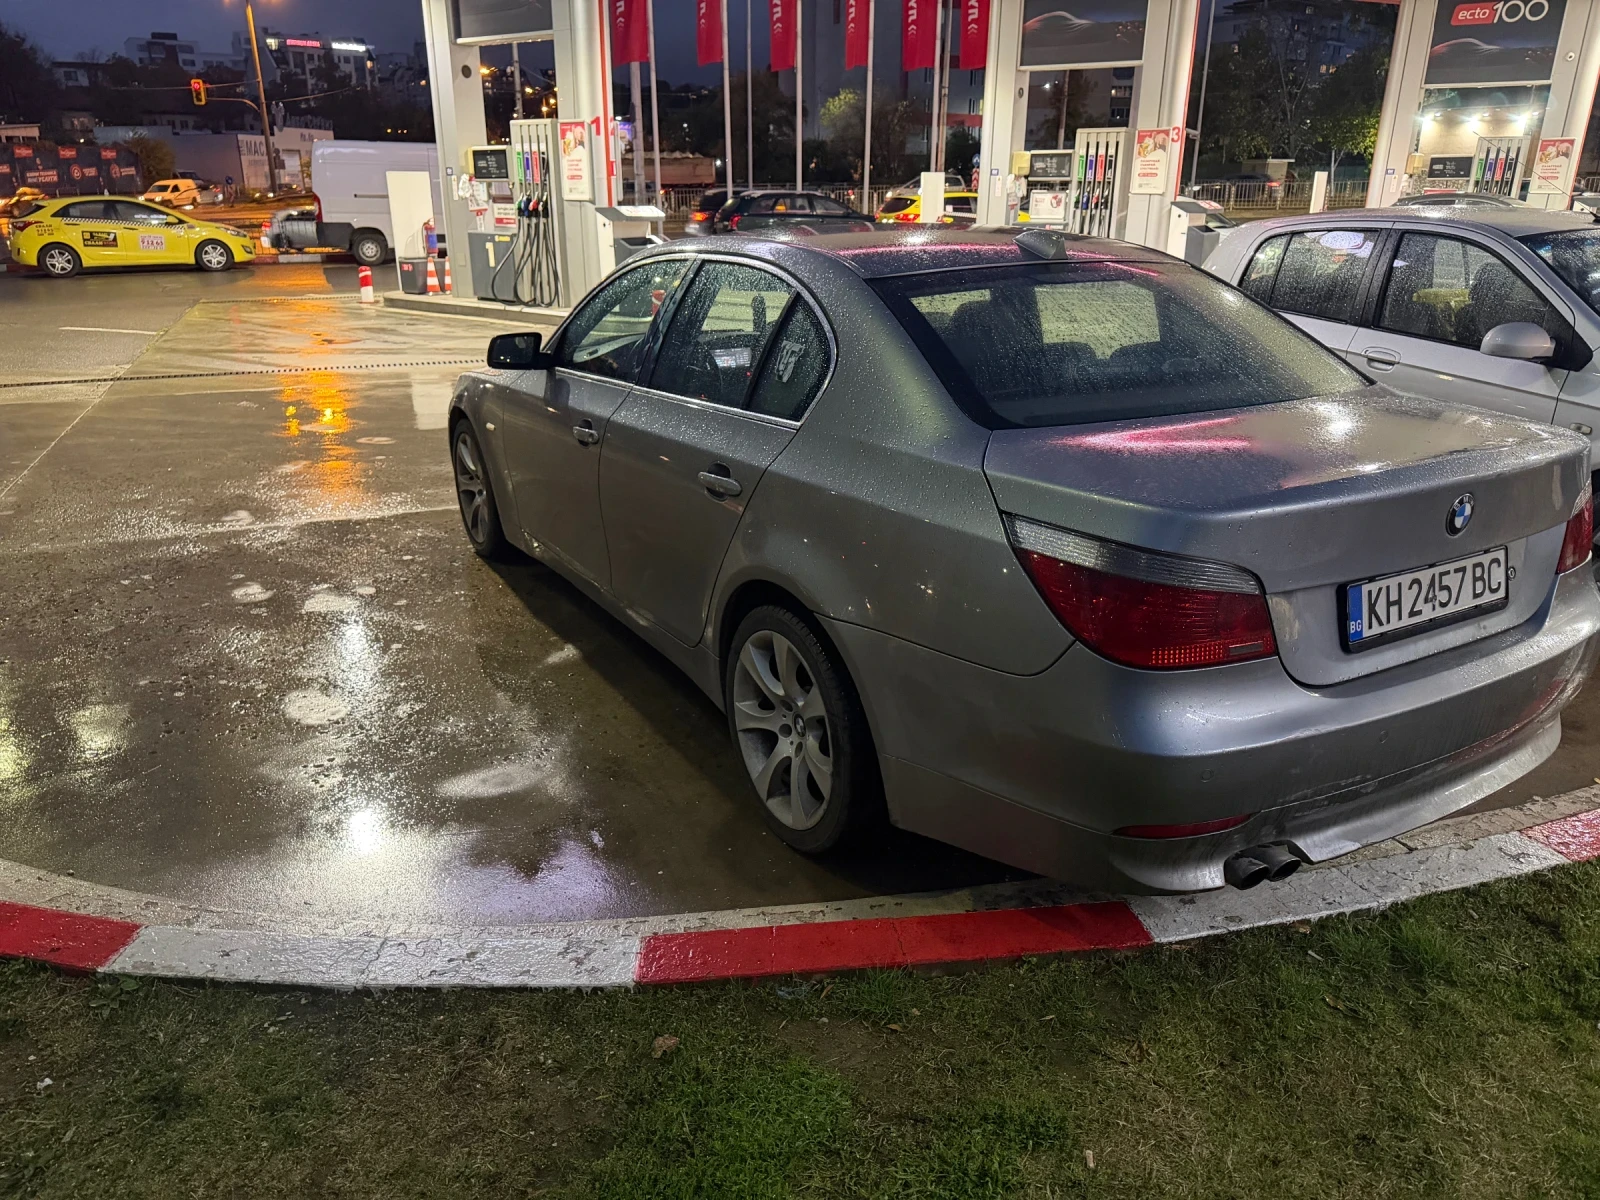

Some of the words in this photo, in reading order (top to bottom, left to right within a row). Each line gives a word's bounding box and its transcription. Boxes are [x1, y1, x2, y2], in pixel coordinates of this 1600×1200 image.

[1458, 0, 1549, 23] ecto100
[591, 116, 601, 136] 1
[1171, 126, 1181, 143] 3
[486, 242, 496, 268] 1
[1368, 582, 1402, 630] KH
[1408, 565, 1467, 618] 2457
[1473, 557, 1502, 600] BC
[1350, 620, 1362, 634] BG
